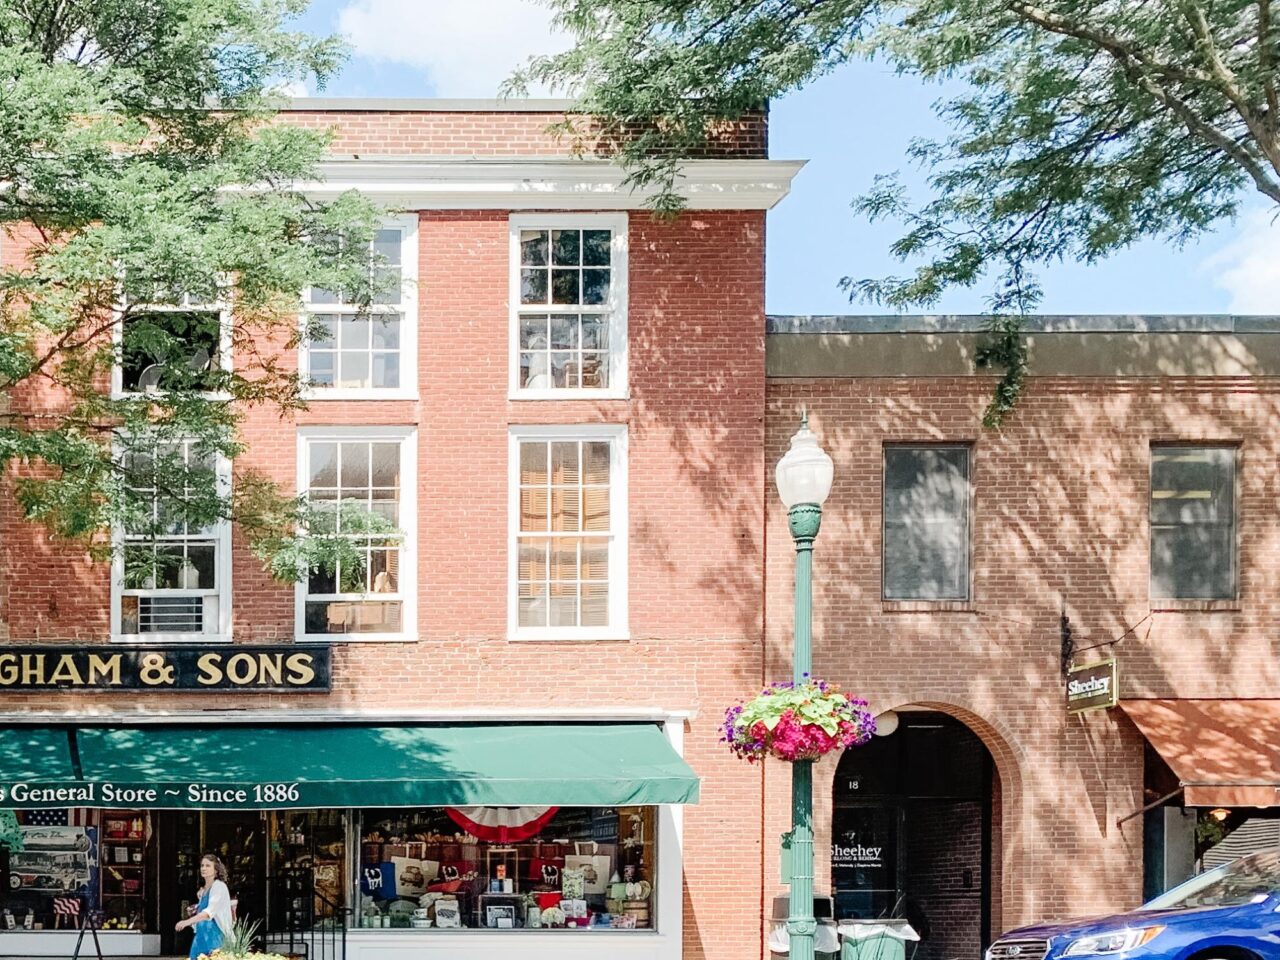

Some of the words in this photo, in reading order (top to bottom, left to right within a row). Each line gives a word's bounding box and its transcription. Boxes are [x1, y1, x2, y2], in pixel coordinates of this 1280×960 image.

[139, 653, 175, 685] &
[196, 653, 315, 685] SONS
[1068, 676, 1110, 695] Sheehey
[10, 783, 95, 802] General
[101, 784, 157, 802] Store
[188, 785, 247, 803] Since
[252, 783, 300, 803] 1886
[849, 781, 859, 790] 18
